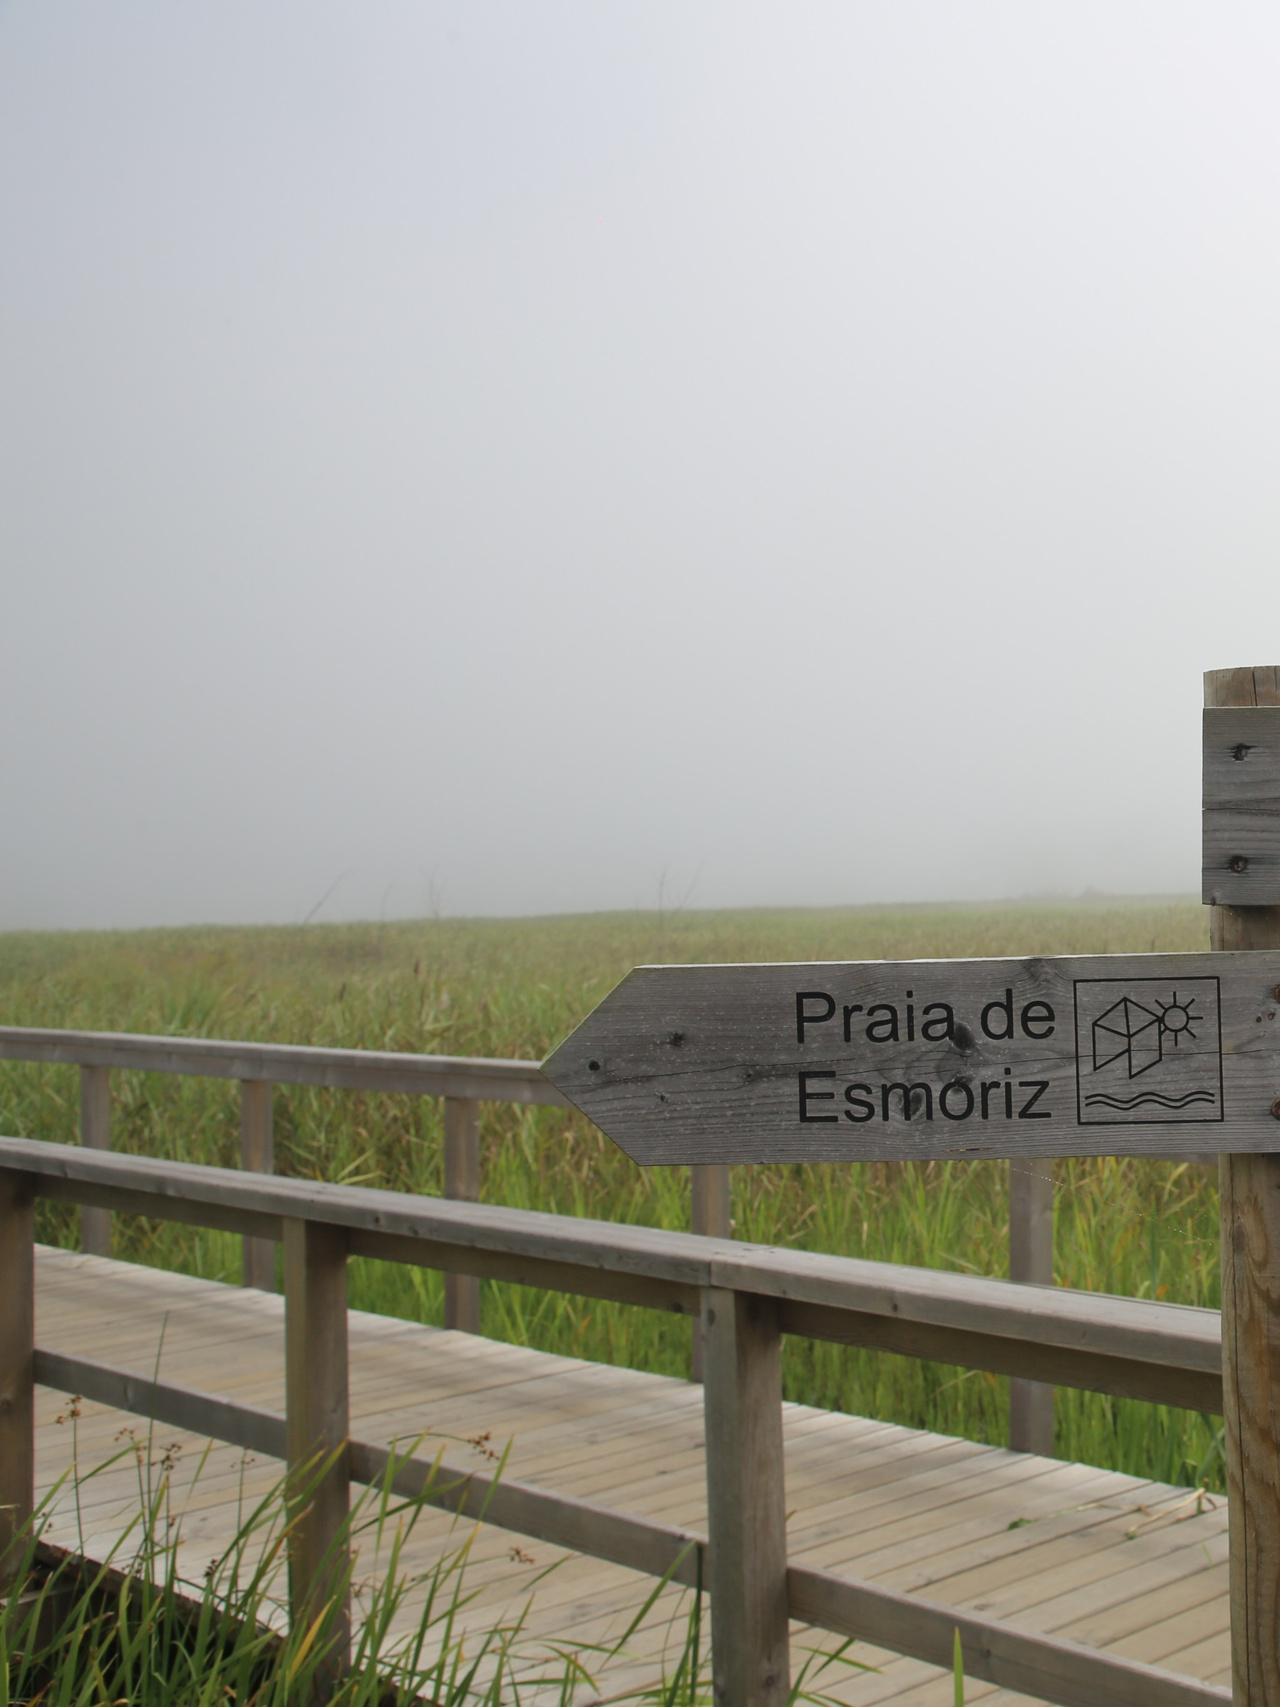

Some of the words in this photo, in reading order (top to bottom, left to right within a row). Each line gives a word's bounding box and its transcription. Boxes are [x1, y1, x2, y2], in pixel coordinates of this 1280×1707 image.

[795, 990, 956, 1044] Praia
[980, 987, 1056, 1039] de
[797, 1067, 1052, 1123] Esmoriz
